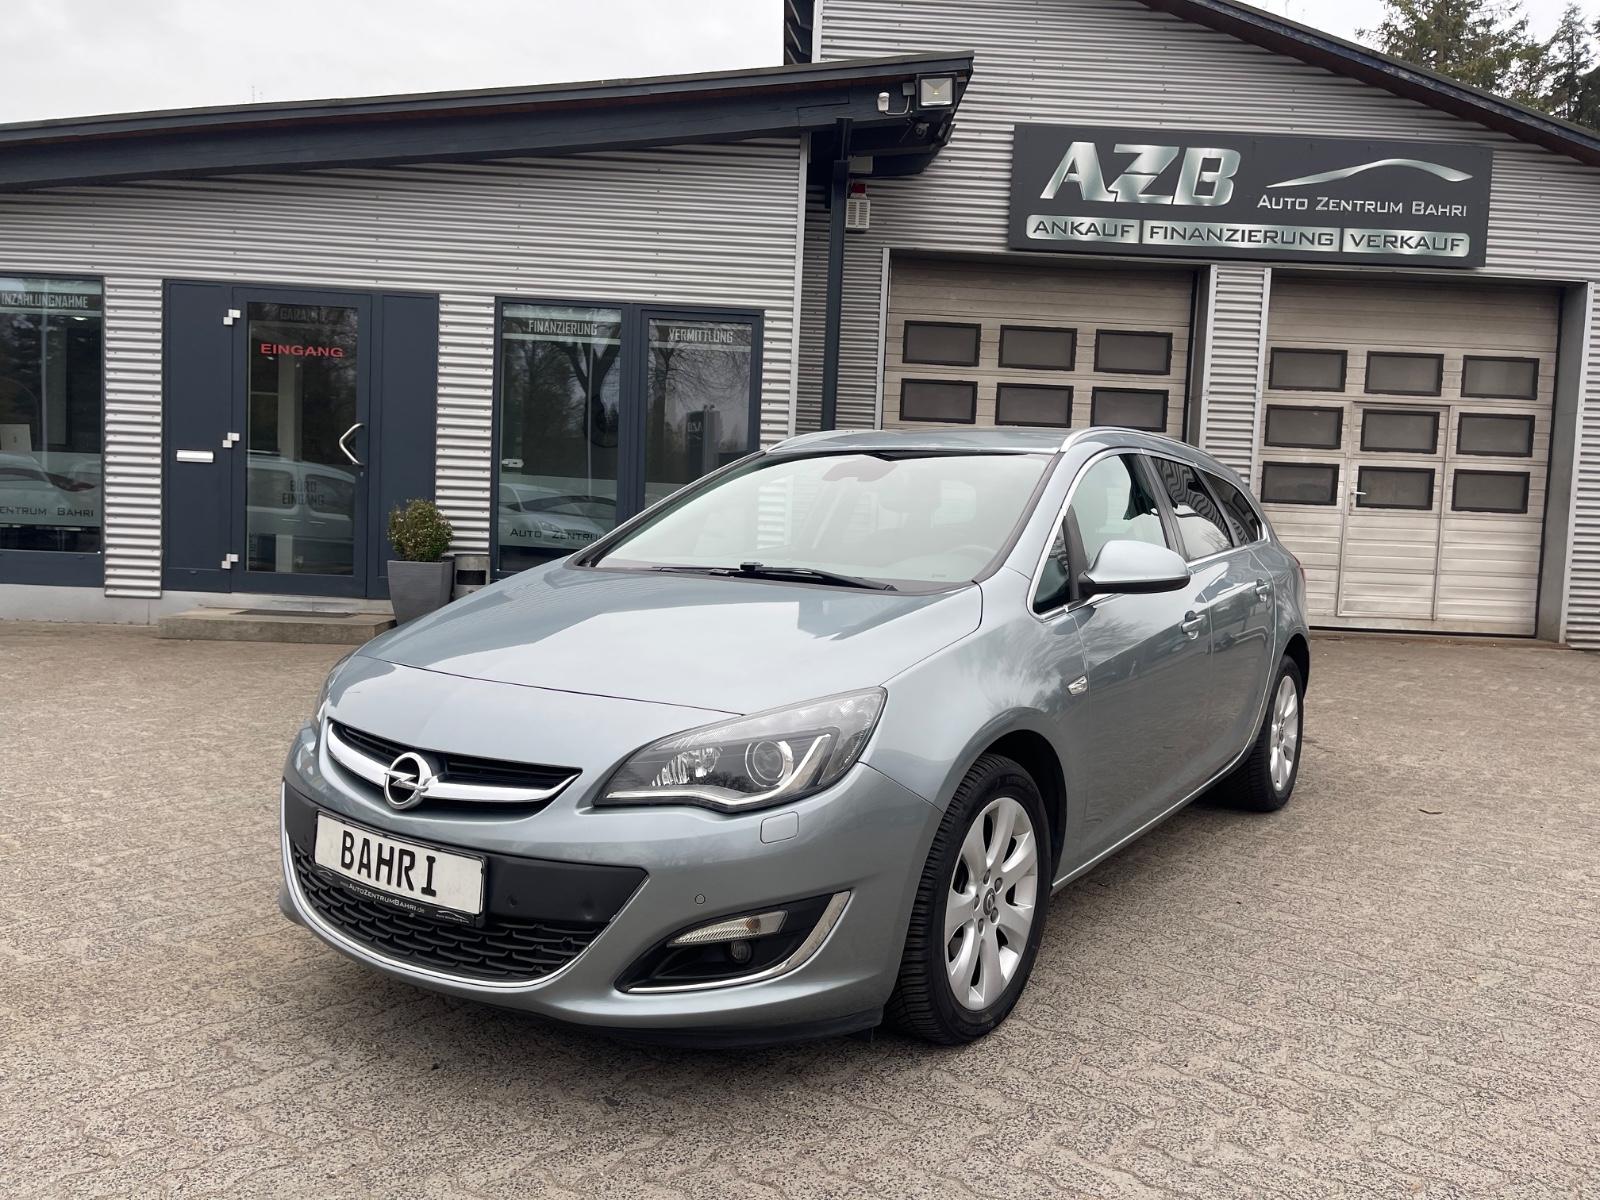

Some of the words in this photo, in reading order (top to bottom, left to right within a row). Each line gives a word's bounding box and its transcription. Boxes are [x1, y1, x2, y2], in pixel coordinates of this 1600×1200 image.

[1040, 141, 1241, 206] AZB
[1257, 194, 1309, 211] AUTO
[1316, 196, 1403, 214] ZENTRUM
[1411, 200, 1468, 217] BAHRI
[1032, 220, 1136, 238] ANKAUF
[1149, 225, 1334, 247] FINANZIERUNG
[1350, 233, 1465, 252] VERKAUF
[1, 292, 89, 309] INZAHLUNGNAHME
[528, 320, 598, 336] FINANZIERUNG
[668, 328, 734, 343] VERMITTLUNG
[260, 343, 343, 357] EINGANG
[57, 507, 94, 517] BAHRI
[510, 528, 541, 538] AUTO
[552, 530, 601, 541] ZENTRU
[341, 830, 437, 898] BAHRI
